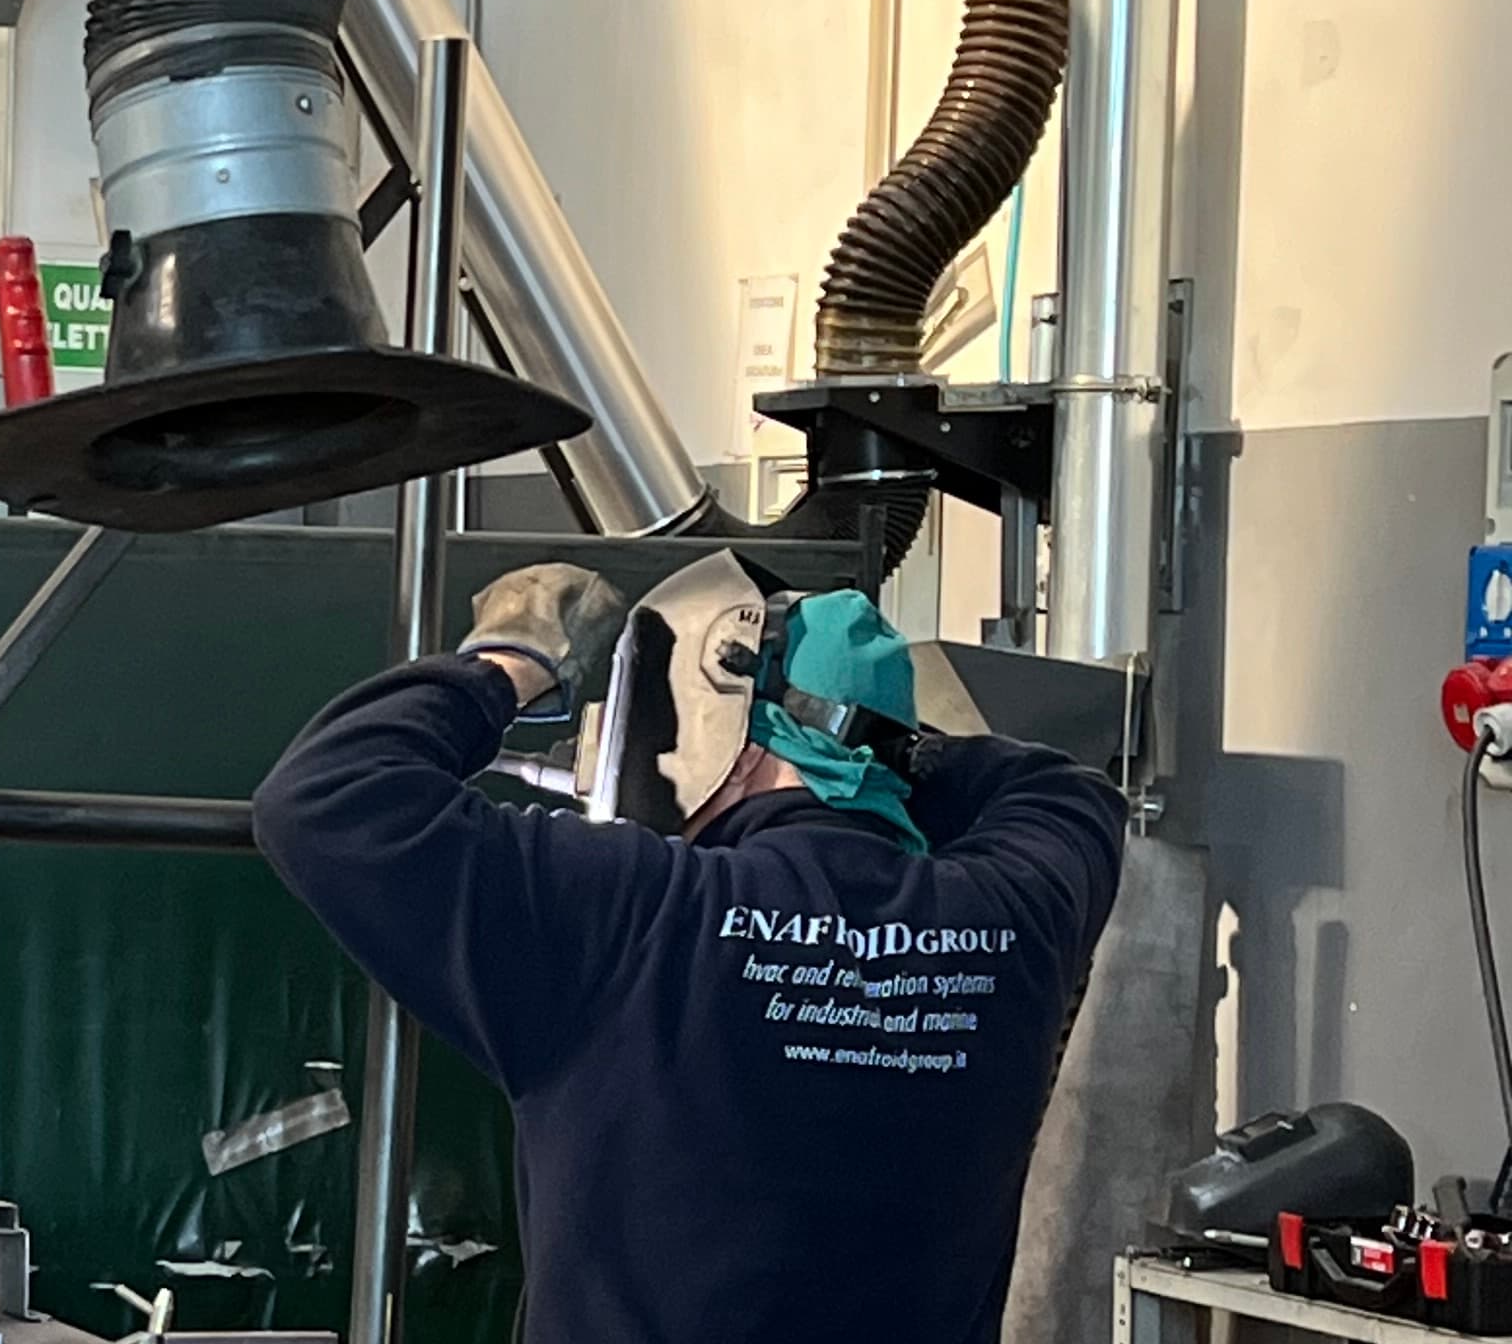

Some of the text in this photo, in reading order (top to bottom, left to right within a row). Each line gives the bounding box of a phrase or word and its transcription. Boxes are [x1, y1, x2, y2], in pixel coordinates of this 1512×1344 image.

[54, 282, 113, 311] QUA
[47, 322, 109, 350] LETT
[742, 953, 789, 984] hvac
[792, 959, 834, 986] and
[932, 971, 996, 999] systems
[765, 992, 796, 1021] for
[884, 1006, 918, 1032] and
